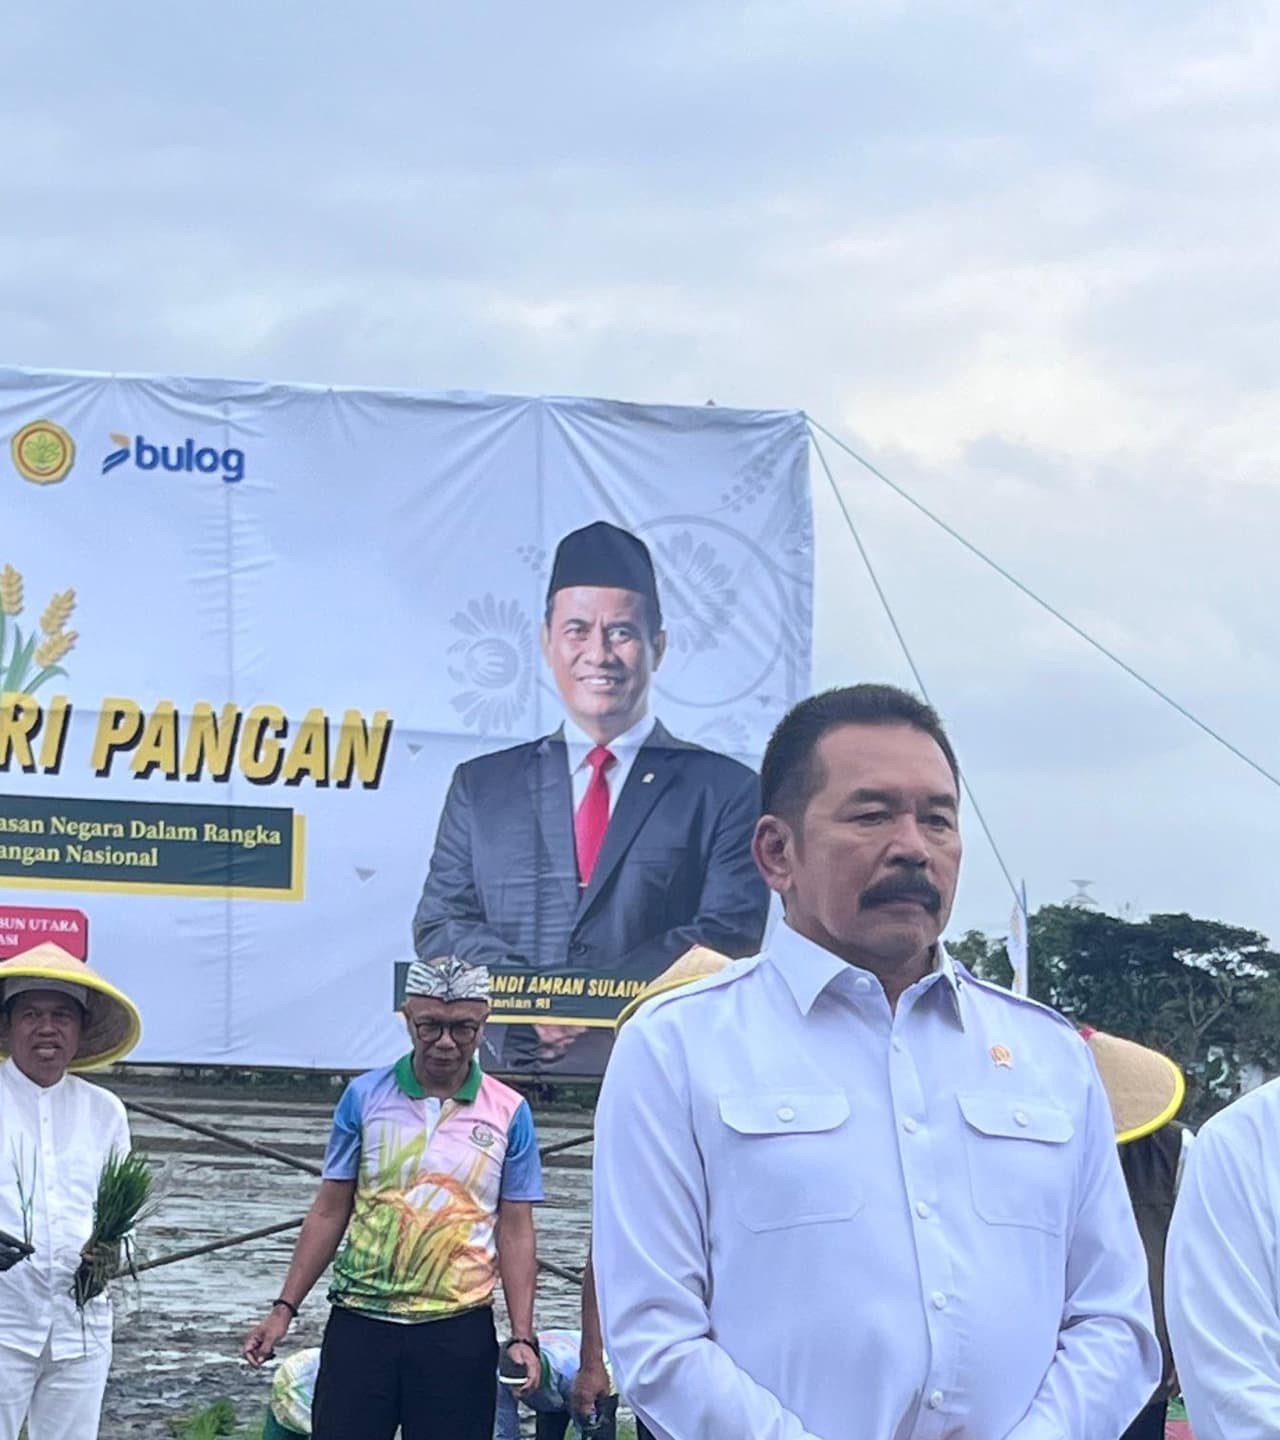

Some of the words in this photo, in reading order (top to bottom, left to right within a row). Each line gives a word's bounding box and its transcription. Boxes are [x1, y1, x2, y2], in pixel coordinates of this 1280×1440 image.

[135, 435, 245, 483] bulog
[90, 696, 394, 789] PANGAN
[51, 817, 124, 841] Negara
[130, 821, 198, 842] Dalam
[203, 824, 281, 848] Rangka
[65, 845, 159, 867] Nasional
[29, 918, 79, 932] UTARA
[528, 976, 585, 996] AMRAN
